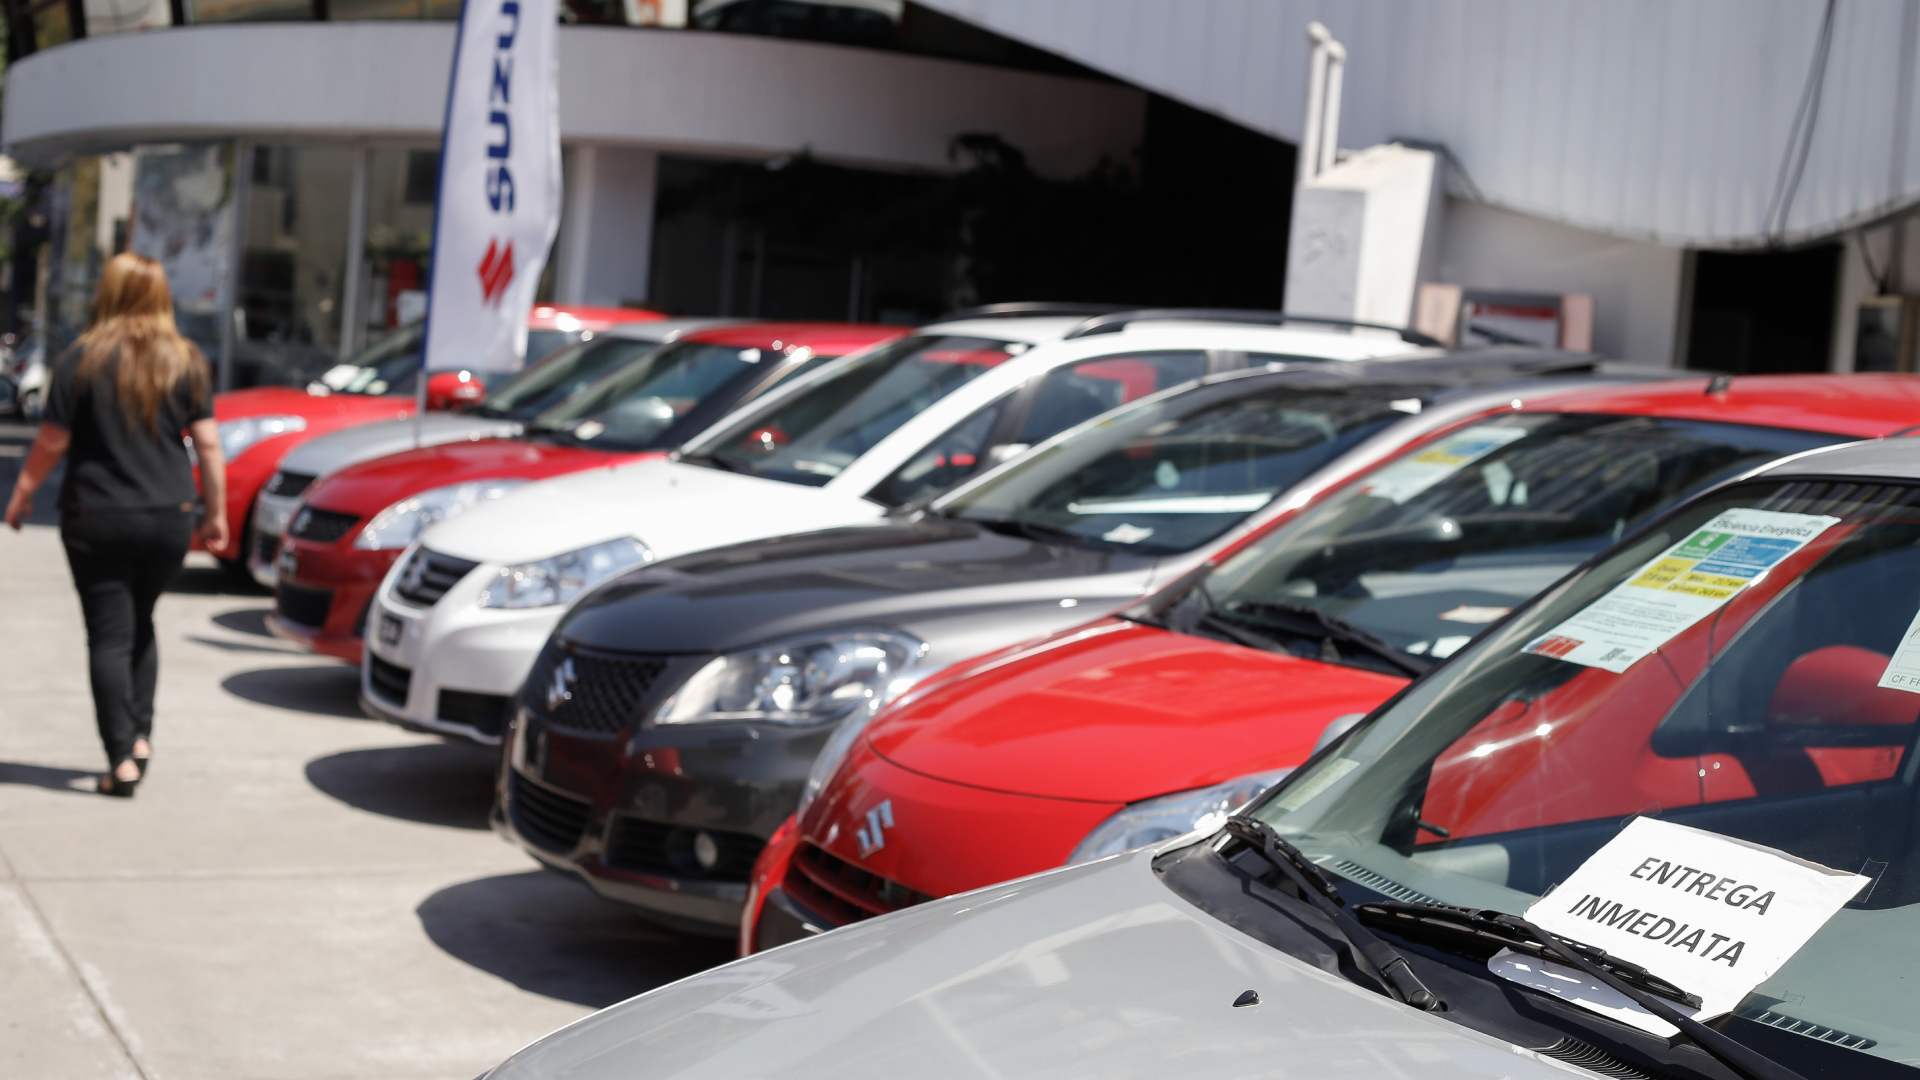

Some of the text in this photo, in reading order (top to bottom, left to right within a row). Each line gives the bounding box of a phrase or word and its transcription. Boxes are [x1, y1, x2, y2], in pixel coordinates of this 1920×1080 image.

[487, 1, 520, 212] SUZU
[1631, 857, 1776, 915] ENTREGA
[1568, 895, 1745, 967] INMEDIATA
